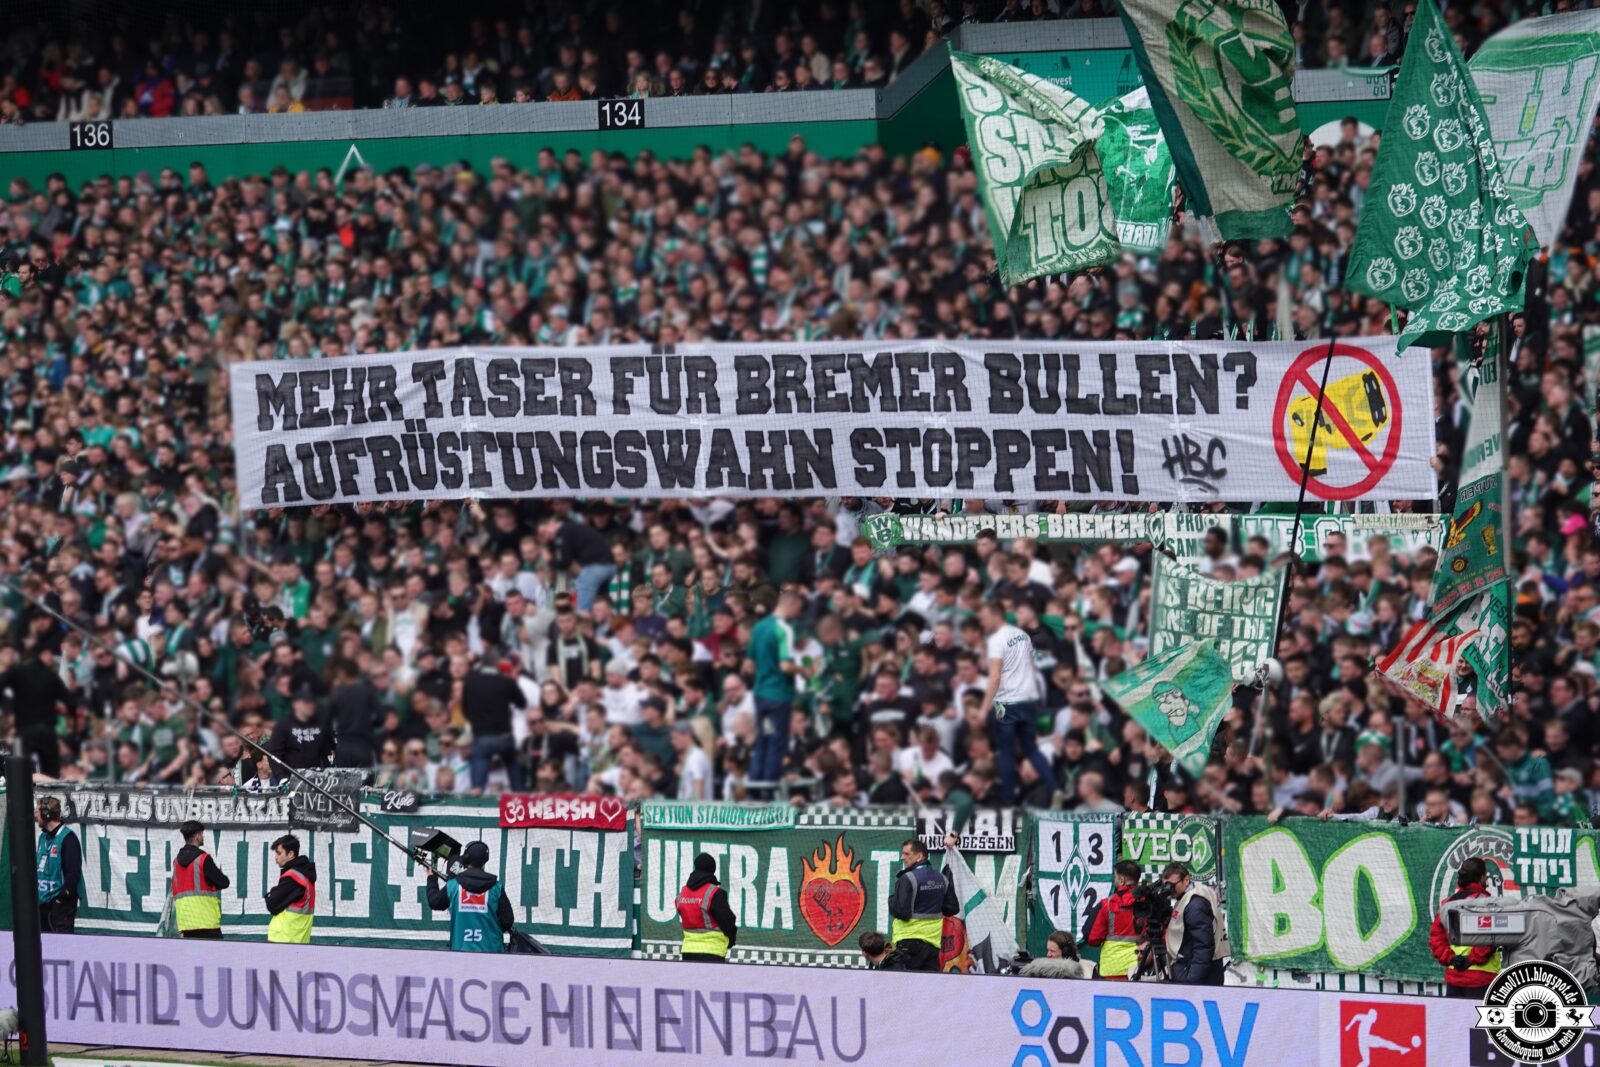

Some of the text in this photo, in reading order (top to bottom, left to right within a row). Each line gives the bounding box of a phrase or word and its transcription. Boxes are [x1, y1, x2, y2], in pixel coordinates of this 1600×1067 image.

[602, 101, 641, 126] 134
[72, 123, 110, 147] 136
[254, 343, 1258, 432] MEHR TASER FÜR BREMER BULLEN?
[261, 418, 1140, 504] AUFRÜSTUNGSWAHN STOPPEN!
[1162, 434, 1228, 481] HBC
[1176, 513, 1204, 532] PRO
[527, 797, 598, 821] HERSH
[1088, 832, 1104, 866] 3
[1516, 858, 1573, 884] ביחד
[463, 929, 483, 942] 25
[1093, 994, 1260, 1067] RBV
